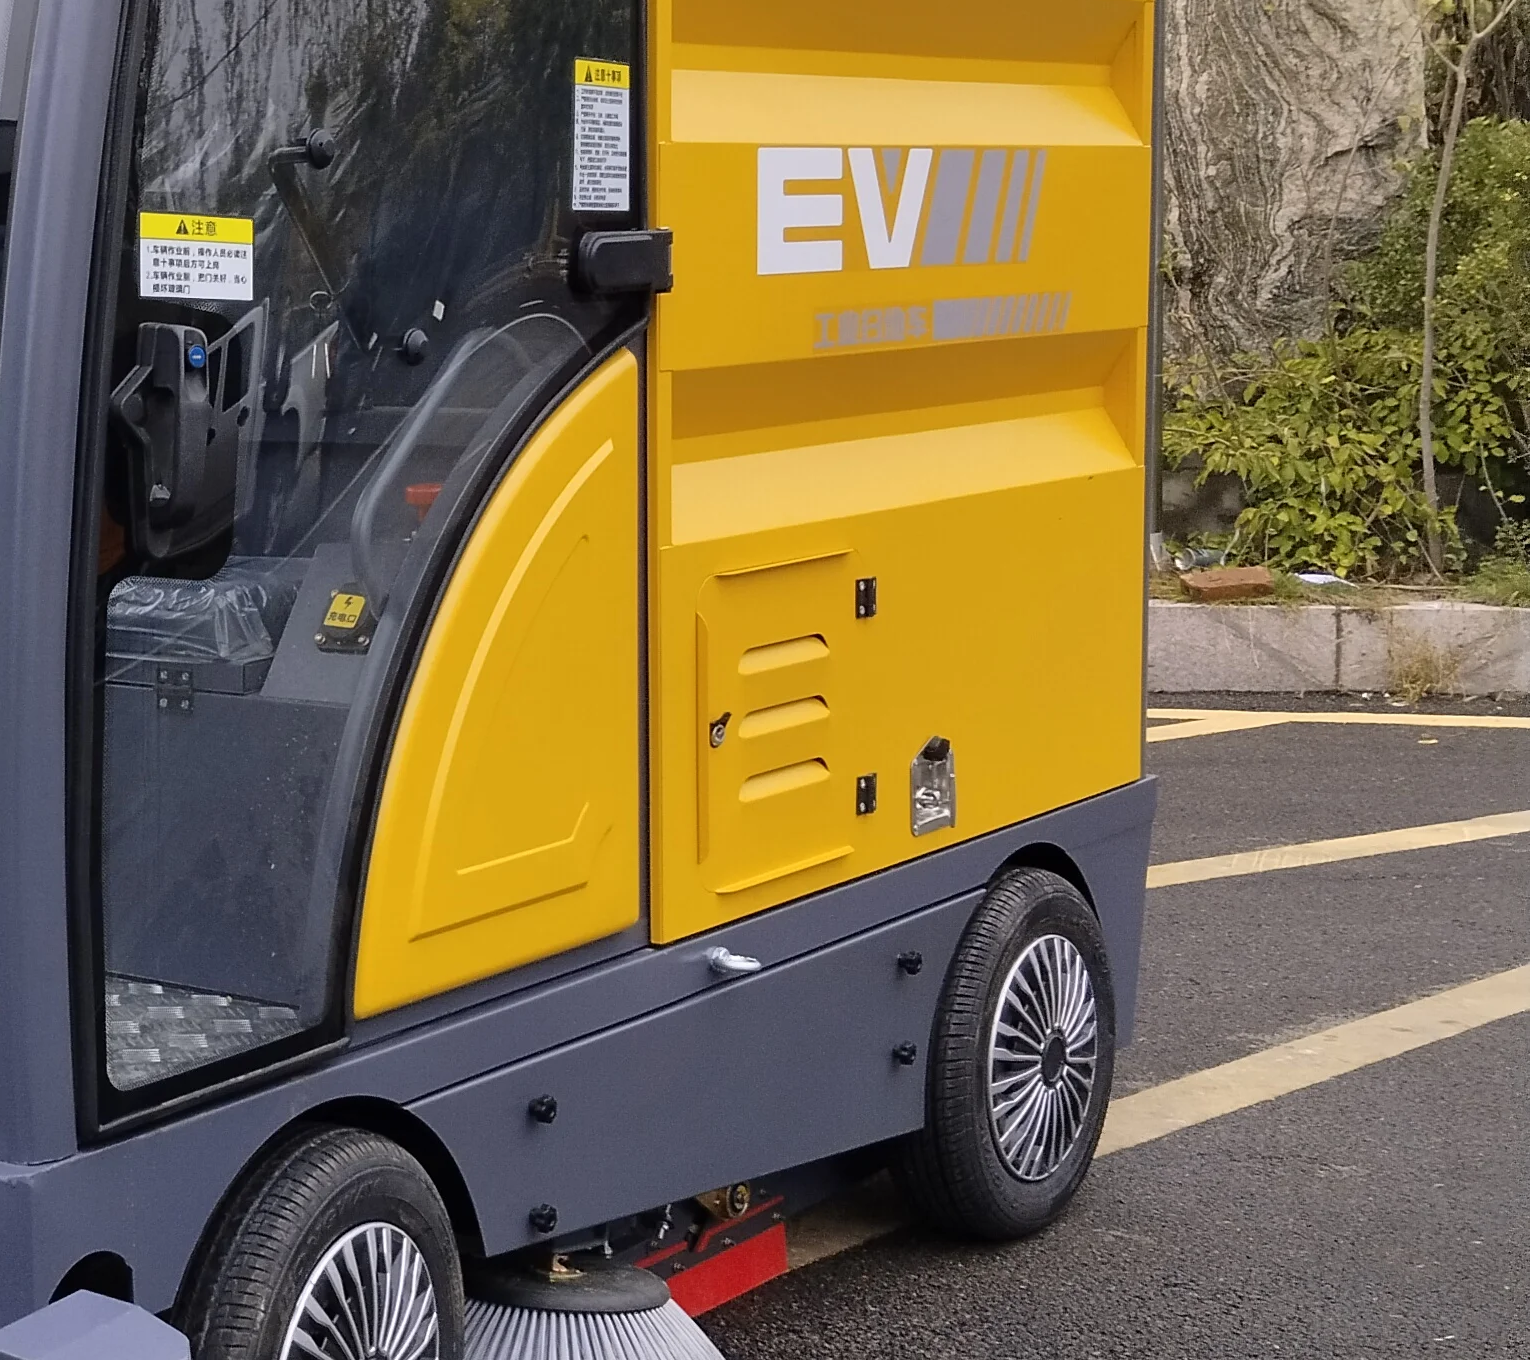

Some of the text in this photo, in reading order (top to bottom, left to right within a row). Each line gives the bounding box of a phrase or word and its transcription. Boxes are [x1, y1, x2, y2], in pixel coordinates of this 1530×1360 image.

[757, 147, 933, 276] EV
[191, 219, 218, 236] 注意
[327, 611, 358, 623] 充电口
